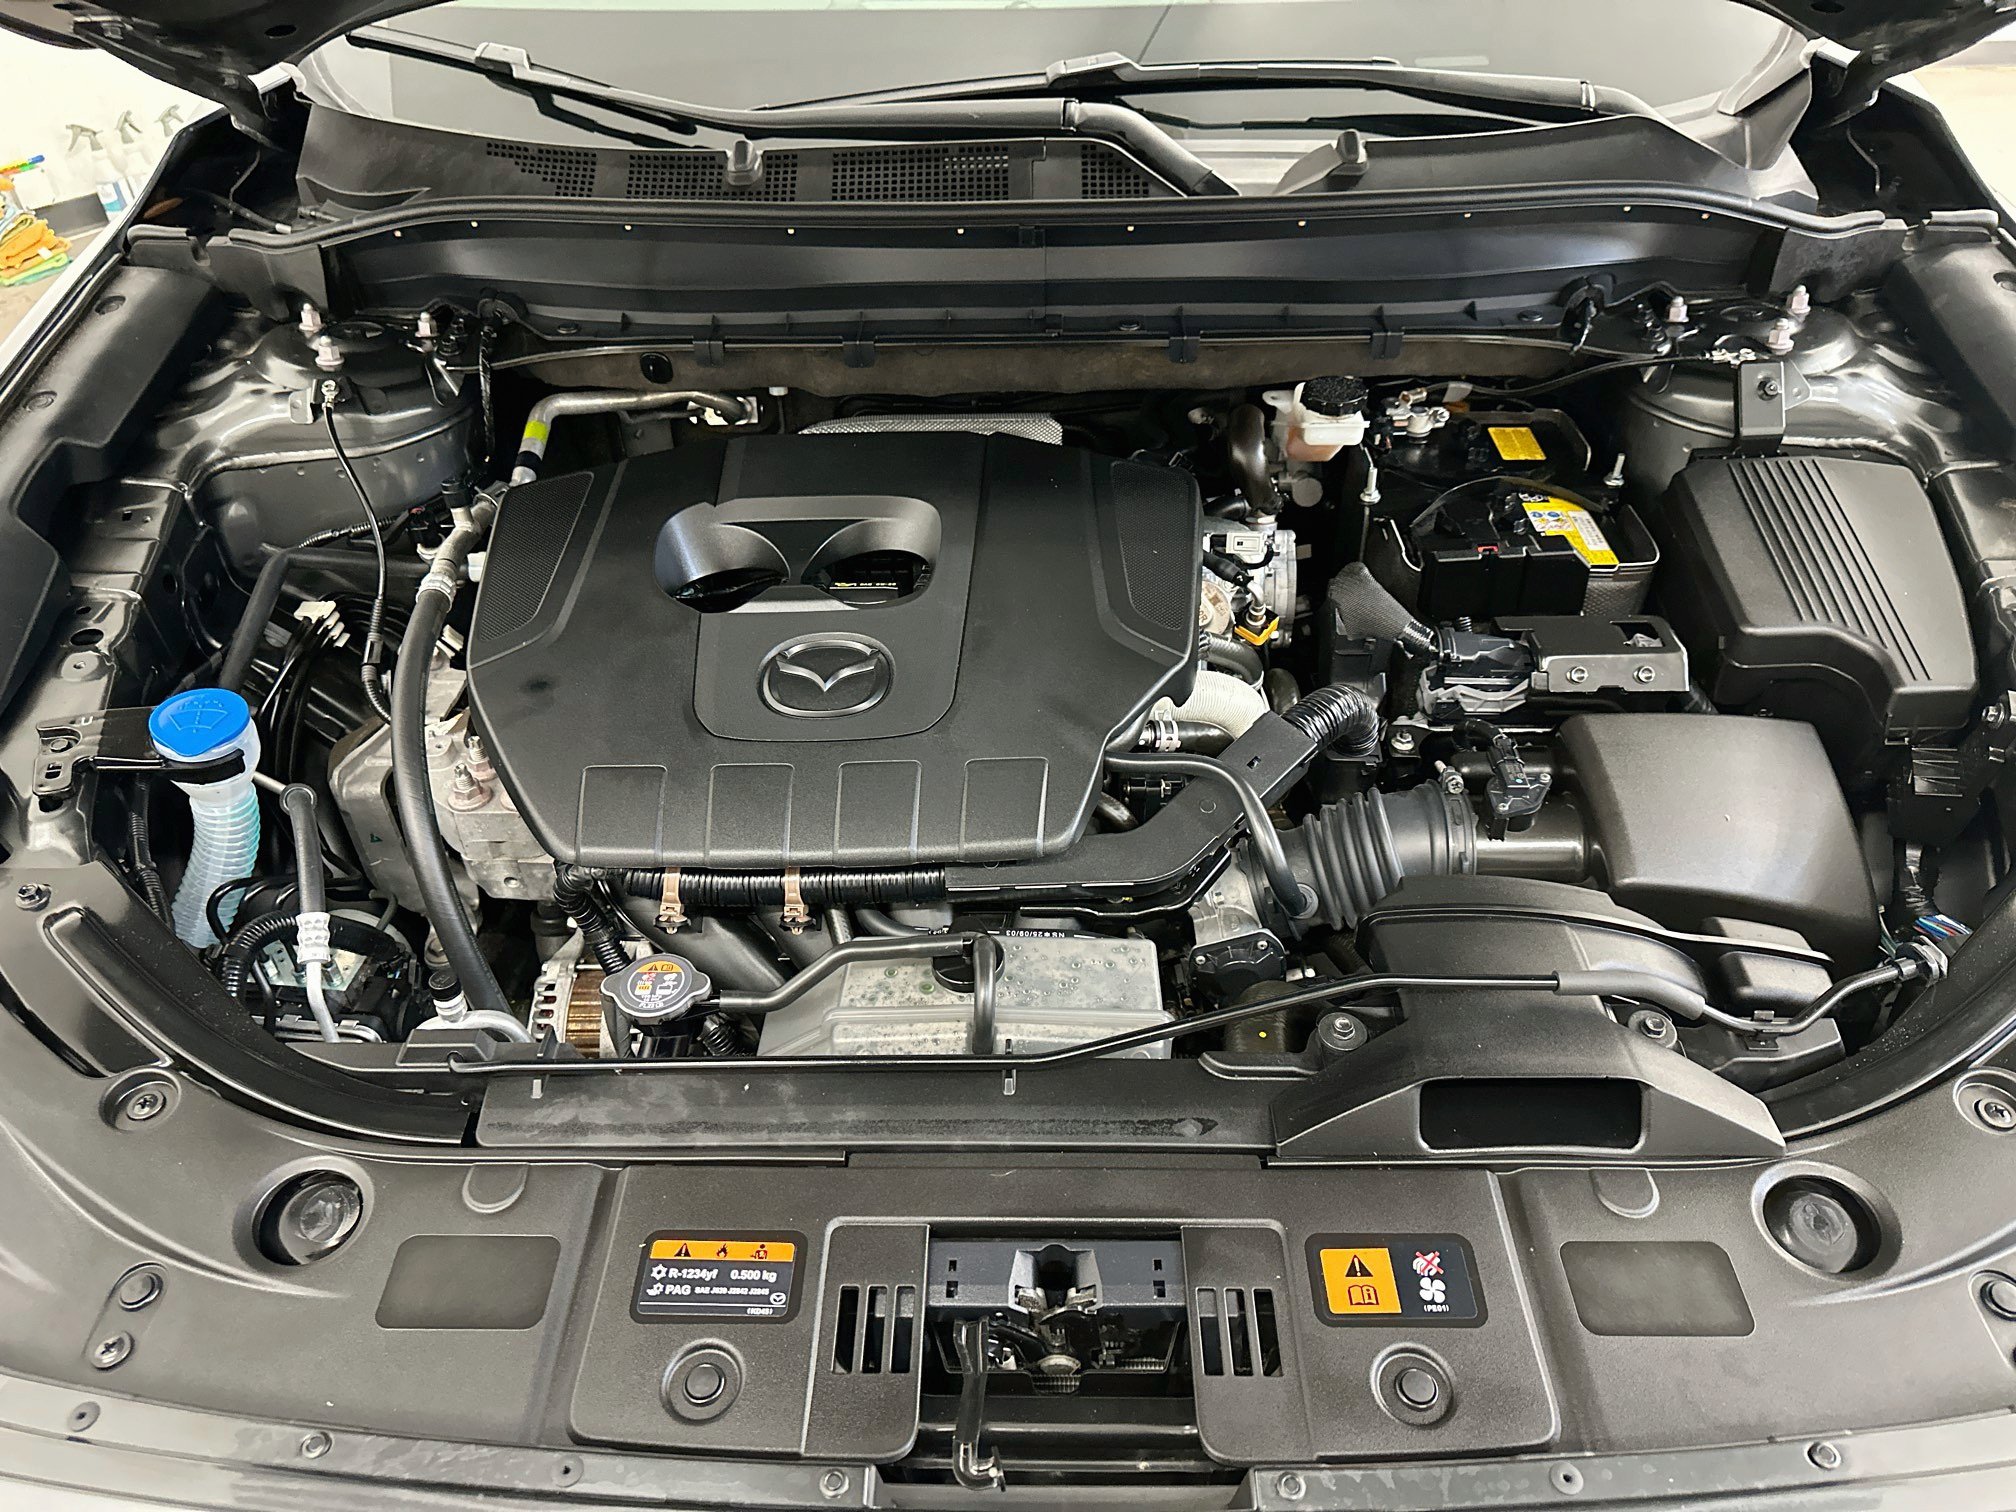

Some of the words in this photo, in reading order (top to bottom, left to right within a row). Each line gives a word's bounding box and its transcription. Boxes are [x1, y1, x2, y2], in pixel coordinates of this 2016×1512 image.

[668, 1267, 719, 1282] R-1234yf
[730, 1268, 761, 1281] 0.500
[761, 1268, 778, 1283] kg
[664, 1284, 692, 1296] PAG
